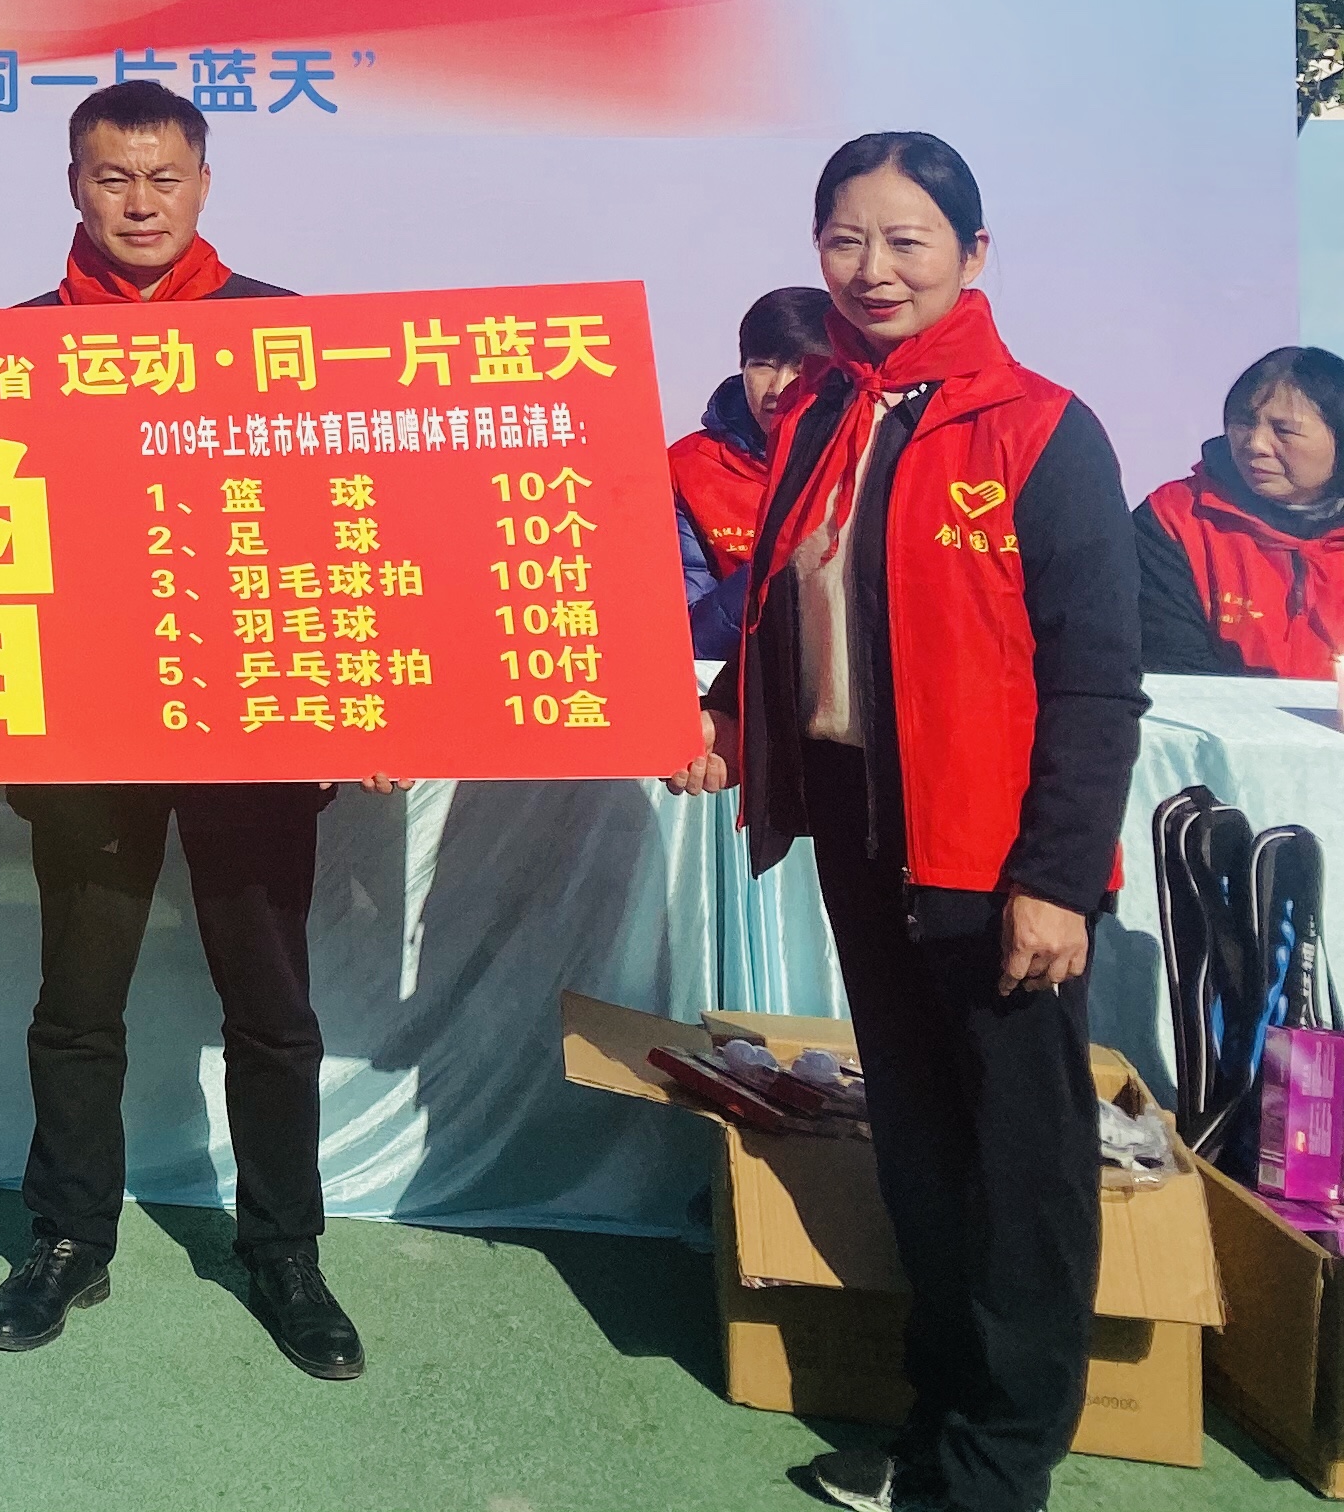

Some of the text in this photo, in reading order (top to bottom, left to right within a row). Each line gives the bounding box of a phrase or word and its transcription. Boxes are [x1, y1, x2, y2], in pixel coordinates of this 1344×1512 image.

[58, 316, 616, 396] 运动·同一片蓝天
[492, 467, 592, 503] 10个
[497, 511, 597, 547] 10个
[935, 524, 1019, 553] 创国卫
[491, 555, 591, 592] 10付
[496, 600, 598, 636] 10桶
[501, 645, 601, 682] 10付
[505, 690, 610, 726] 10盒
